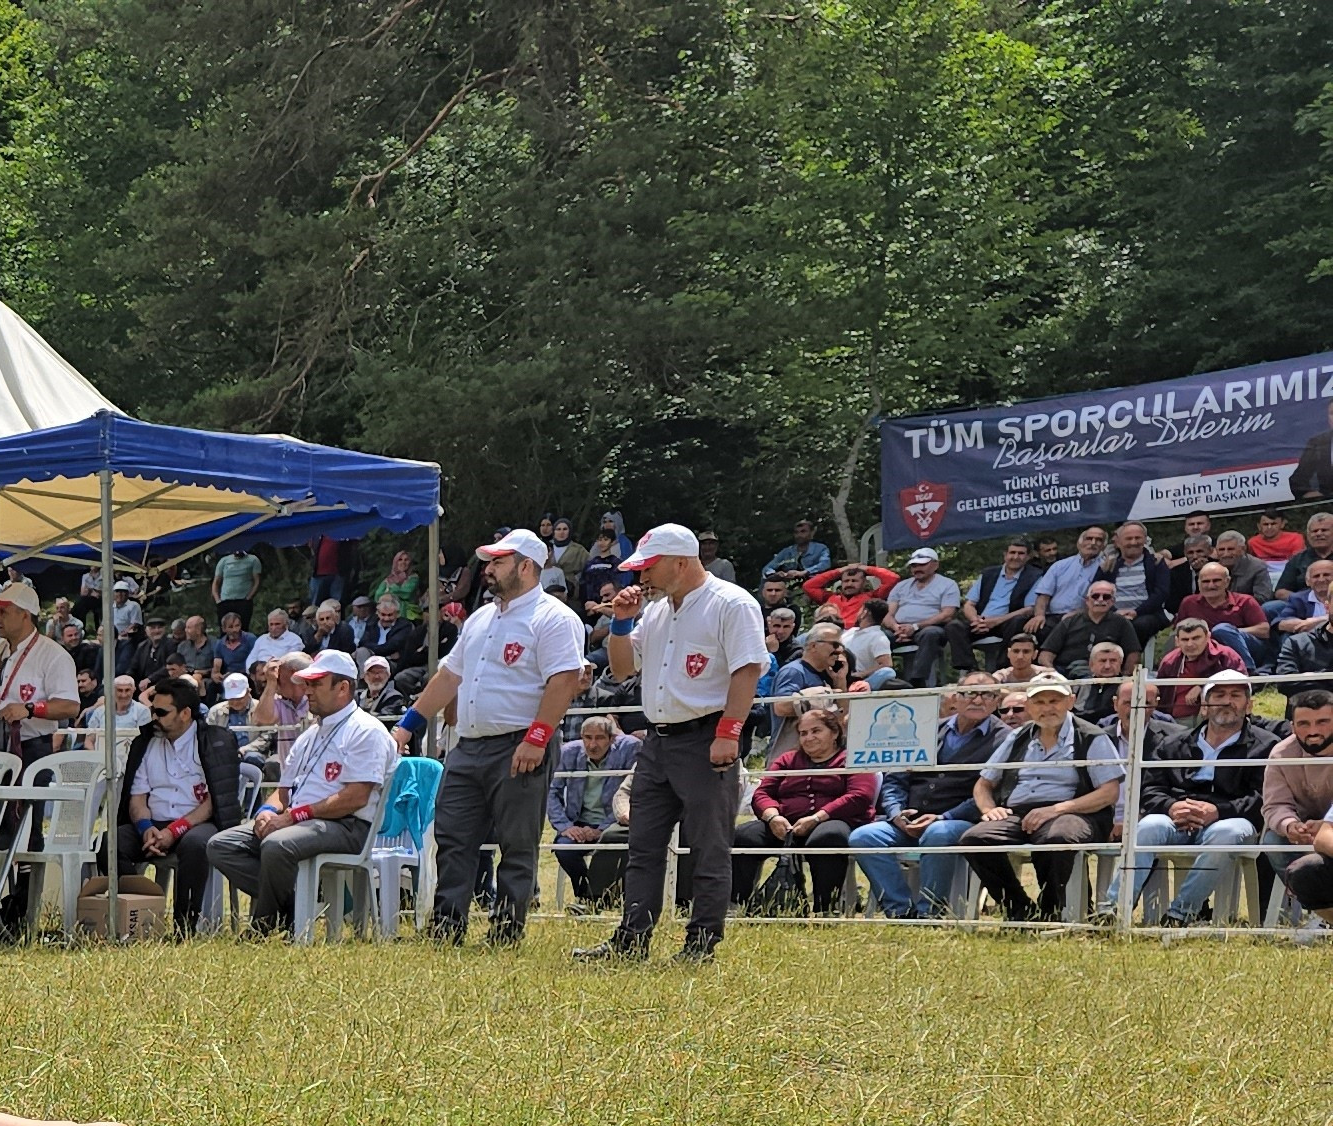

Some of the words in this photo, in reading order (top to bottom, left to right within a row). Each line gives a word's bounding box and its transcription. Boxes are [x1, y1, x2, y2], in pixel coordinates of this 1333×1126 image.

[904, 419, 985, 459] TÜM
[992, 422, 1138, 471] Başarılar
[1146, 406, 1276, 447] Dilerim
[1002, 472, 1060, 491] TÜRKİYE
[1149, 484, 1212, 501] İbrahim
[1217, 471, 1281, 492] TÜRKİŞ
[956, 494, 1036, 513] GELENEKSEL
[1040, 481, 1110, 500] GÜREŞLER
[1205, 488, 1261, 504] BAŞKANI
[985, 500, 1081, 523] FEDERASYONU
[853, 749, 929, 764] ZABITA
